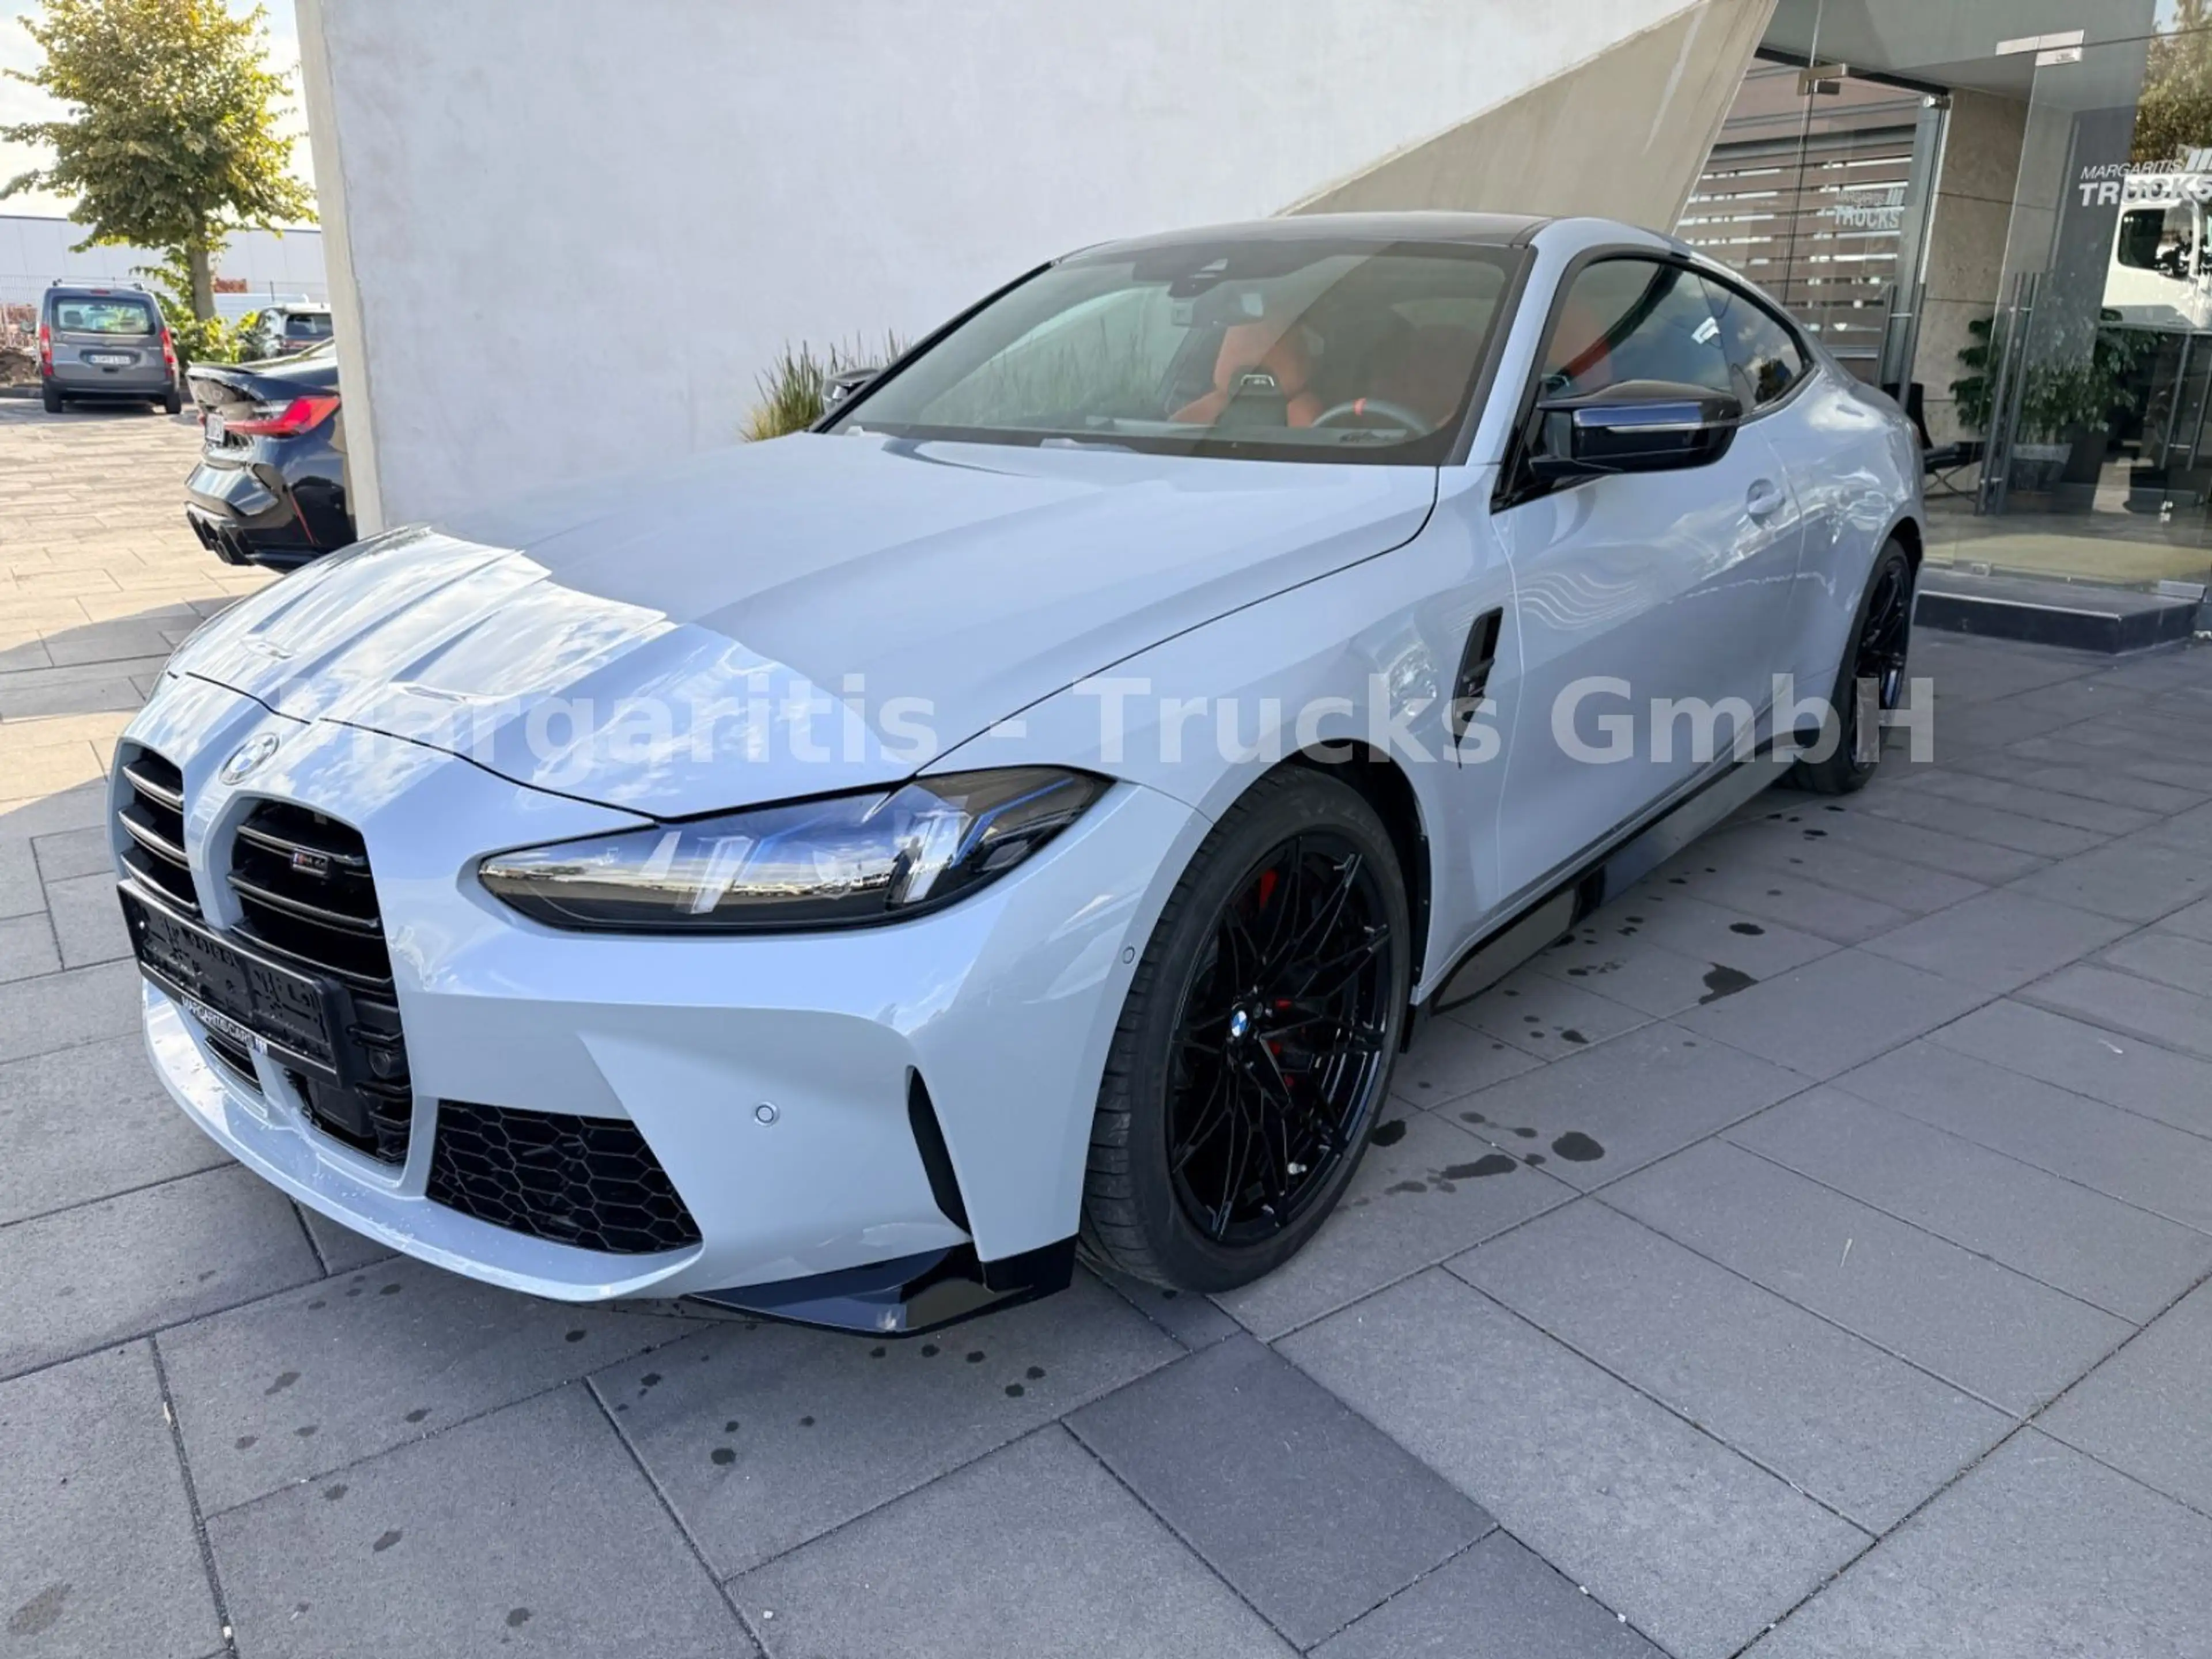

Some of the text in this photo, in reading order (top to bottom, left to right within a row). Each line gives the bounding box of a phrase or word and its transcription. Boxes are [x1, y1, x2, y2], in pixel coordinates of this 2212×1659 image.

[2080, 159, 2183, 180] MARGARITIS
[2078, 176, 2212, 207] TRUCKS
[1834, 205, 1900, 229] TRUCKS
